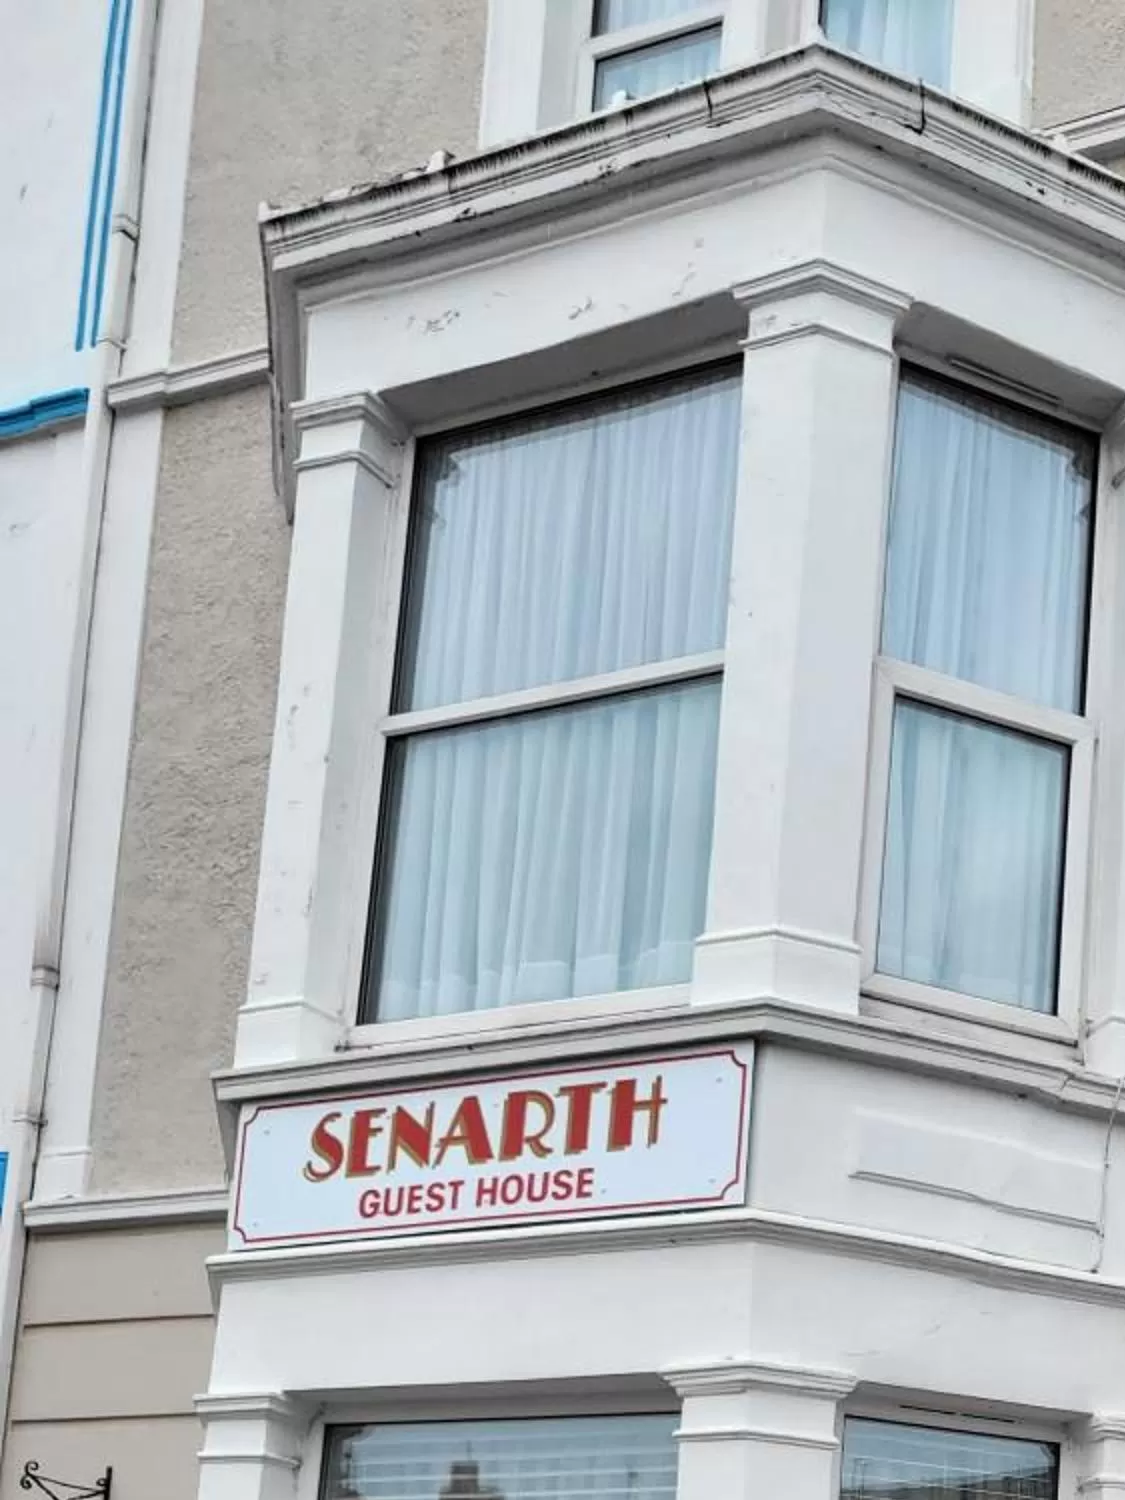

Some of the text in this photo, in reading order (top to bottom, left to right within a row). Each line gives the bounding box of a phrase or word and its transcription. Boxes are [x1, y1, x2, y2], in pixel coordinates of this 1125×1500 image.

[303, 1074, 667, 1183] SENARTH
[358, 1168, 595, 1218] GUEST HOUSE
